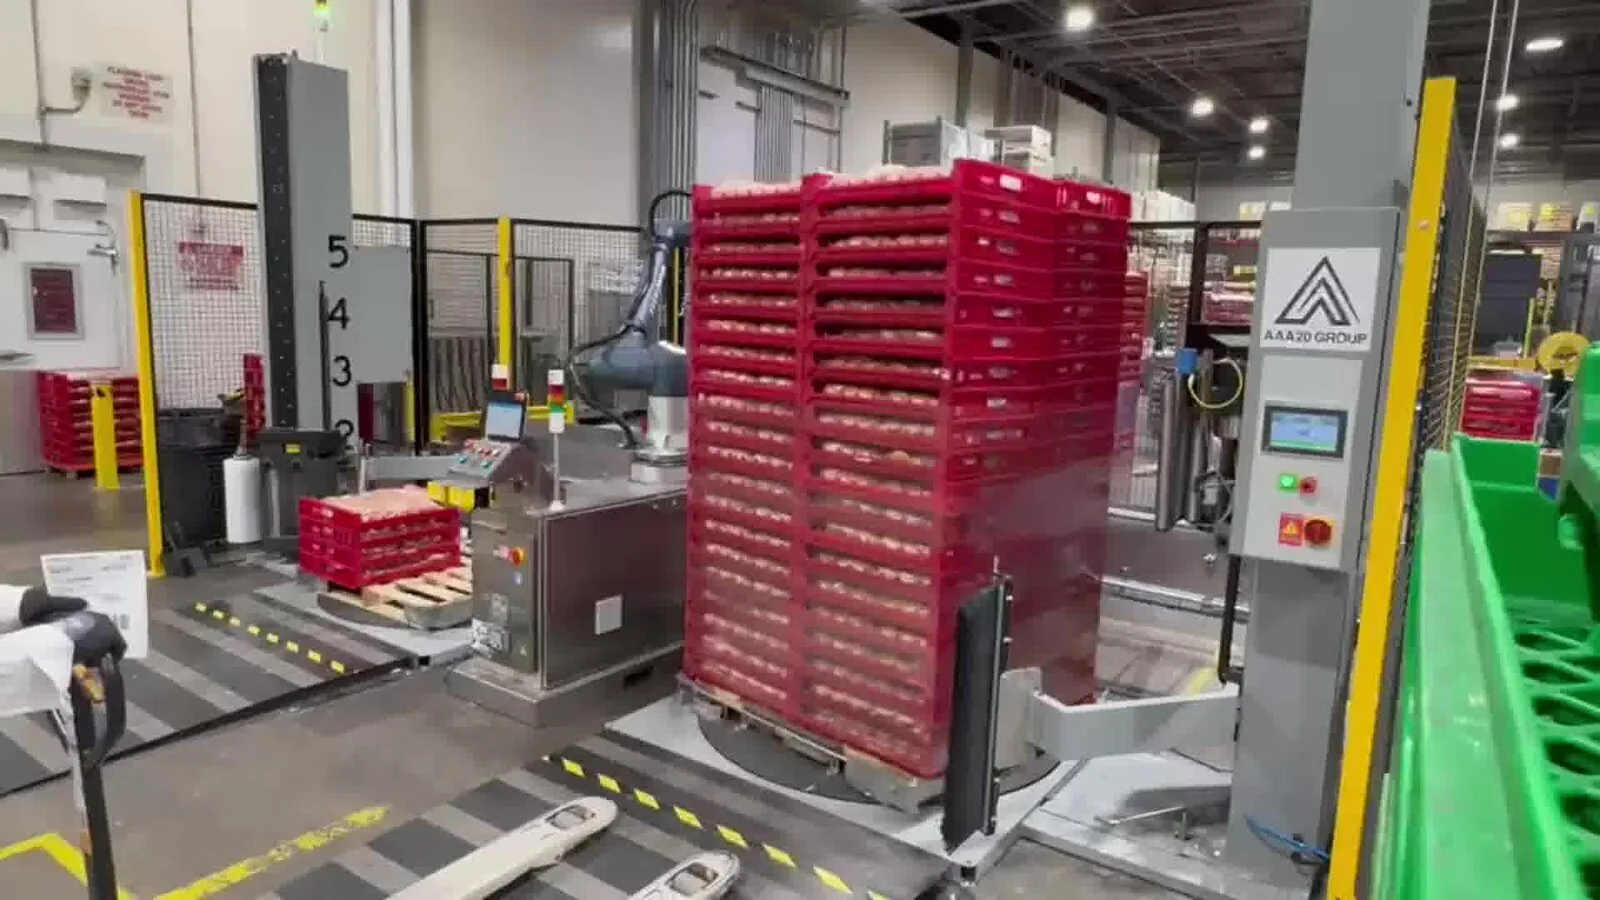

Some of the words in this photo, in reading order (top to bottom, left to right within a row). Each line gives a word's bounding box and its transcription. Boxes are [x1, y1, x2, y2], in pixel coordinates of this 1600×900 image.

[328, 234, 349, 268] 5
[327, 297, 350, 329] 4
[1314, 331, 1367, 344] GROUP
[333, 355, 352, 387] 3
